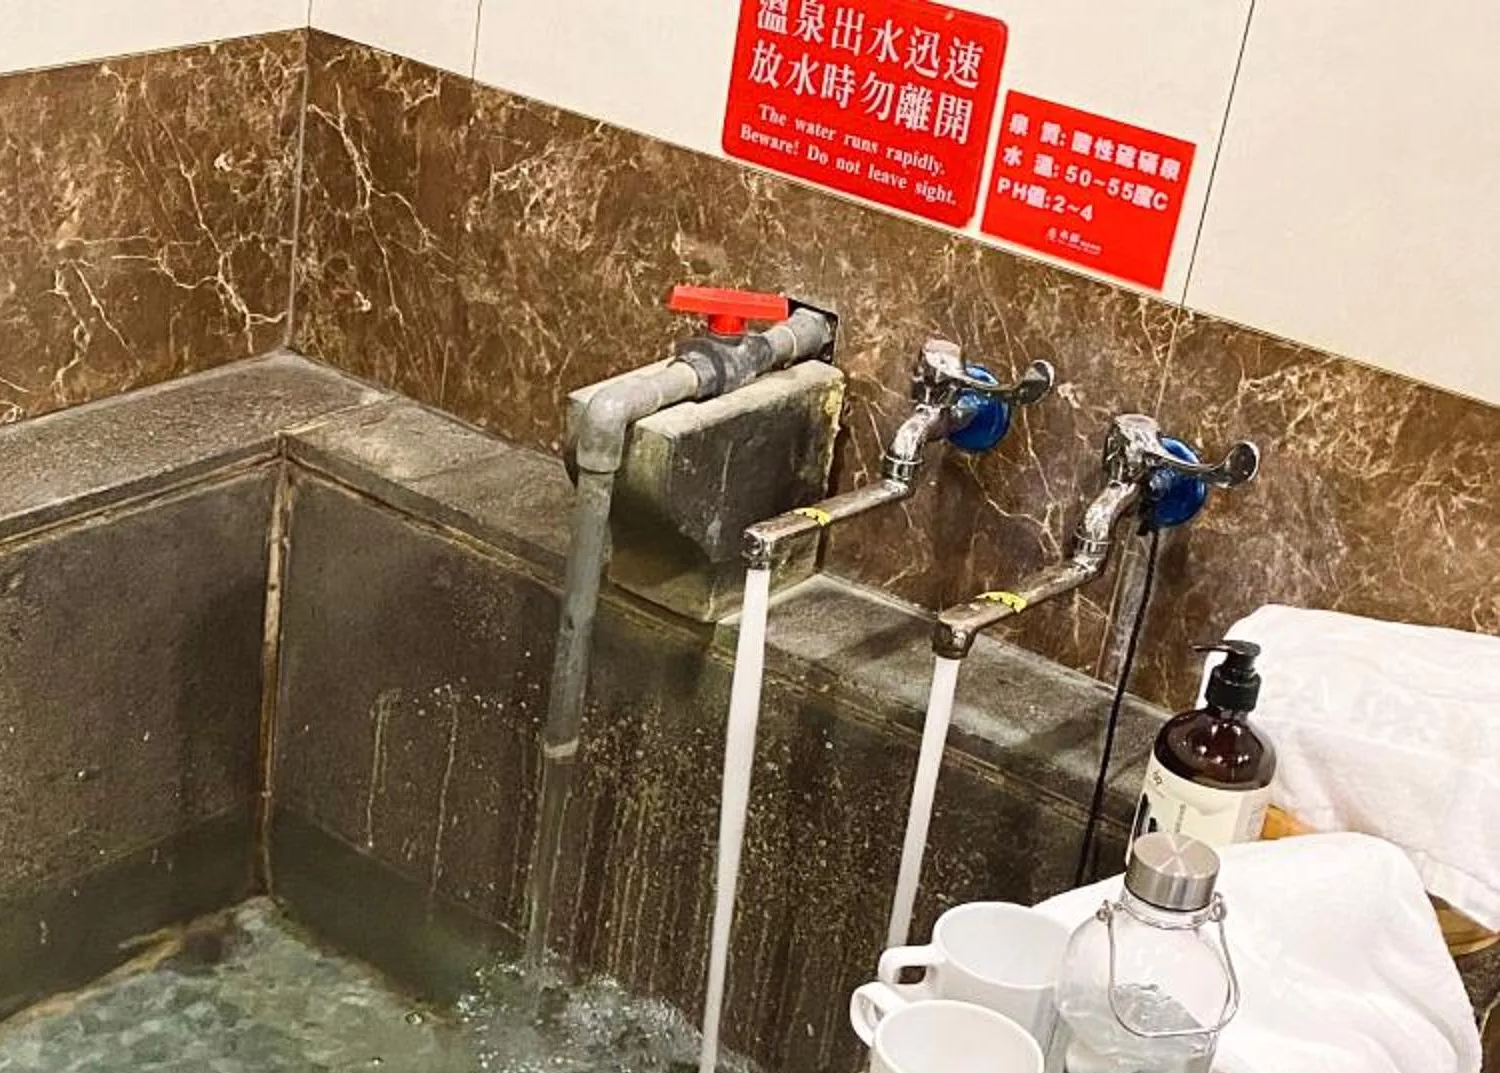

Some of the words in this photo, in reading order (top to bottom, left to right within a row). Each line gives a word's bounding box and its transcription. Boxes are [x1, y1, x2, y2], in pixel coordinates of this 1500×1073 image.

[757, 0, 983, 88] 溫泉出水迅速
[749, 39, 973, 144] 放水時勿離開
[740, 123, 800, 155] Beware!
[807, 145, 829, 165] Do
[836, 156, 861, 175] not
[868, 165, 908, 190] leave
[915, 180, 957, 206] sight.
[759, 103, 788, 126] The
[795, 117, 837, 141] water
[844, 131, 878, 153] runs
[886, 146, 946, 177] rapidly.
